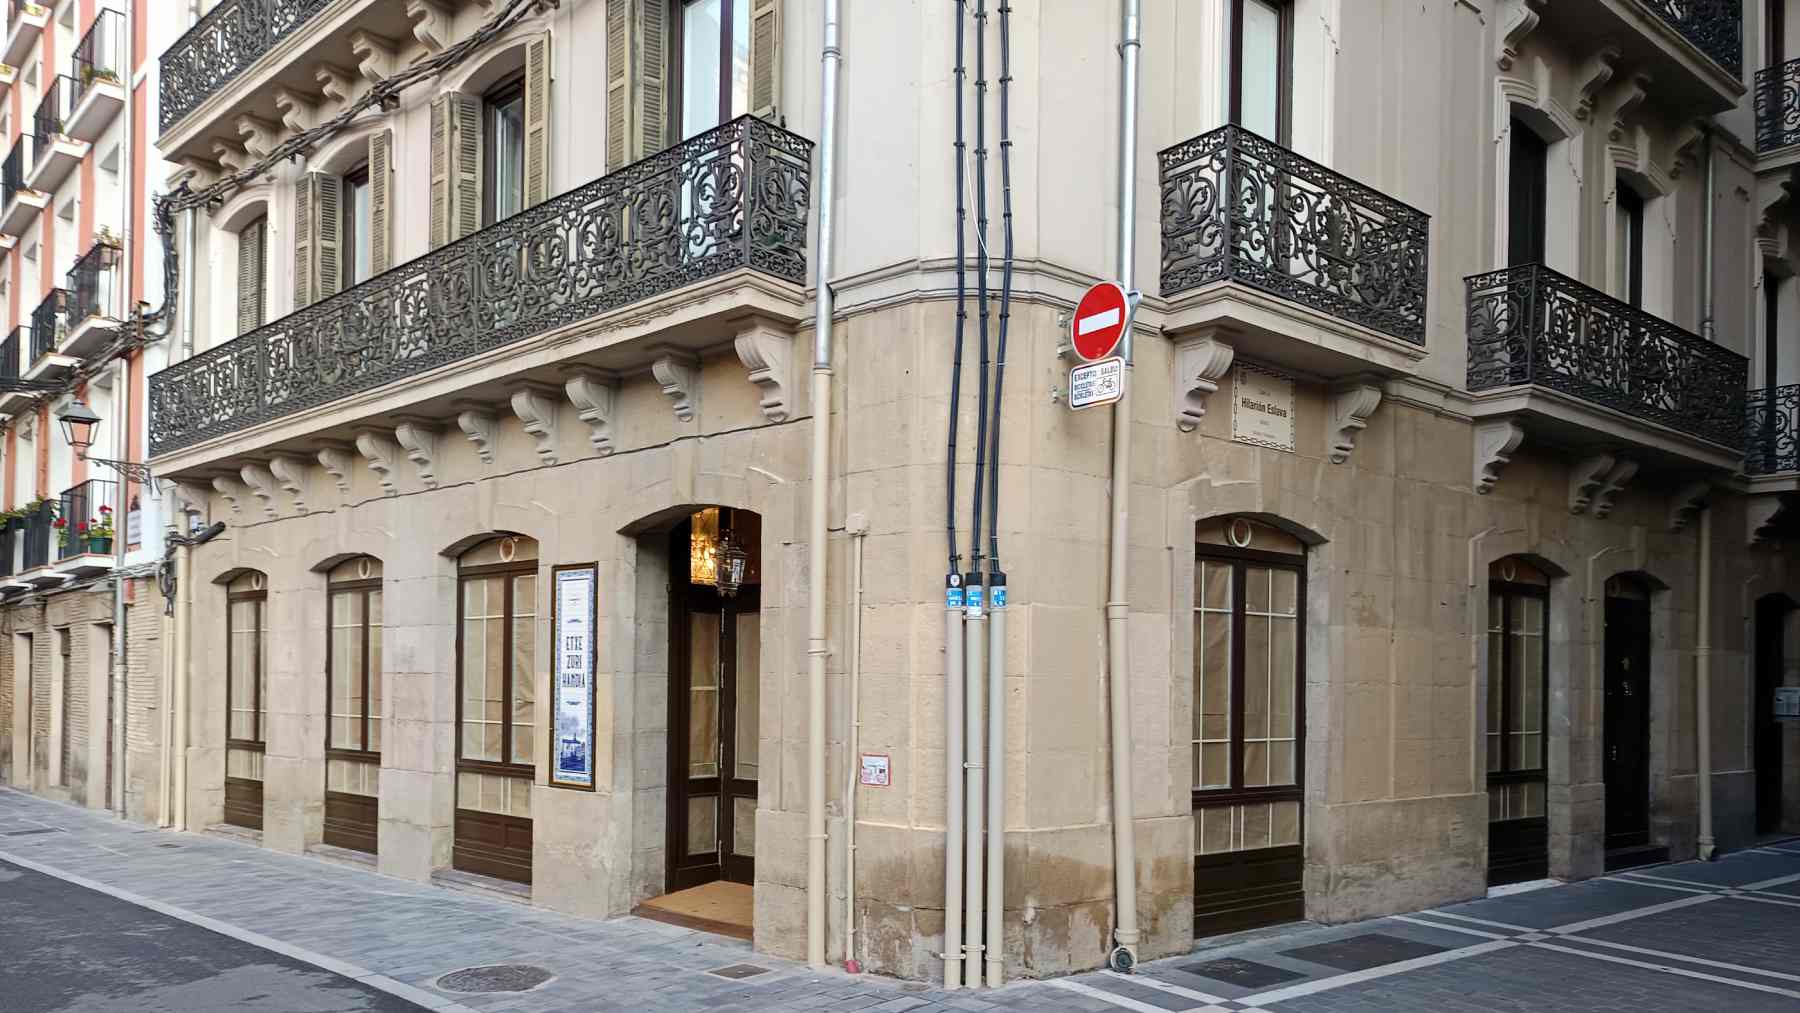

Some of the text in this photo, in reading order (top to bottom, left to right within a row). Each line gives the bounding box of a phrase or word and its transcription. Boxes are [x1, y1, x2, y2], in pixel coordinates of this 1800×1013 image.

[1074, 370, 1097, 382] EXCEPTO
[566, 636, 583, 650] ETXE
[566, 655, 582, 669] ZURI
[562, 672, 586, 688] HANDIA
